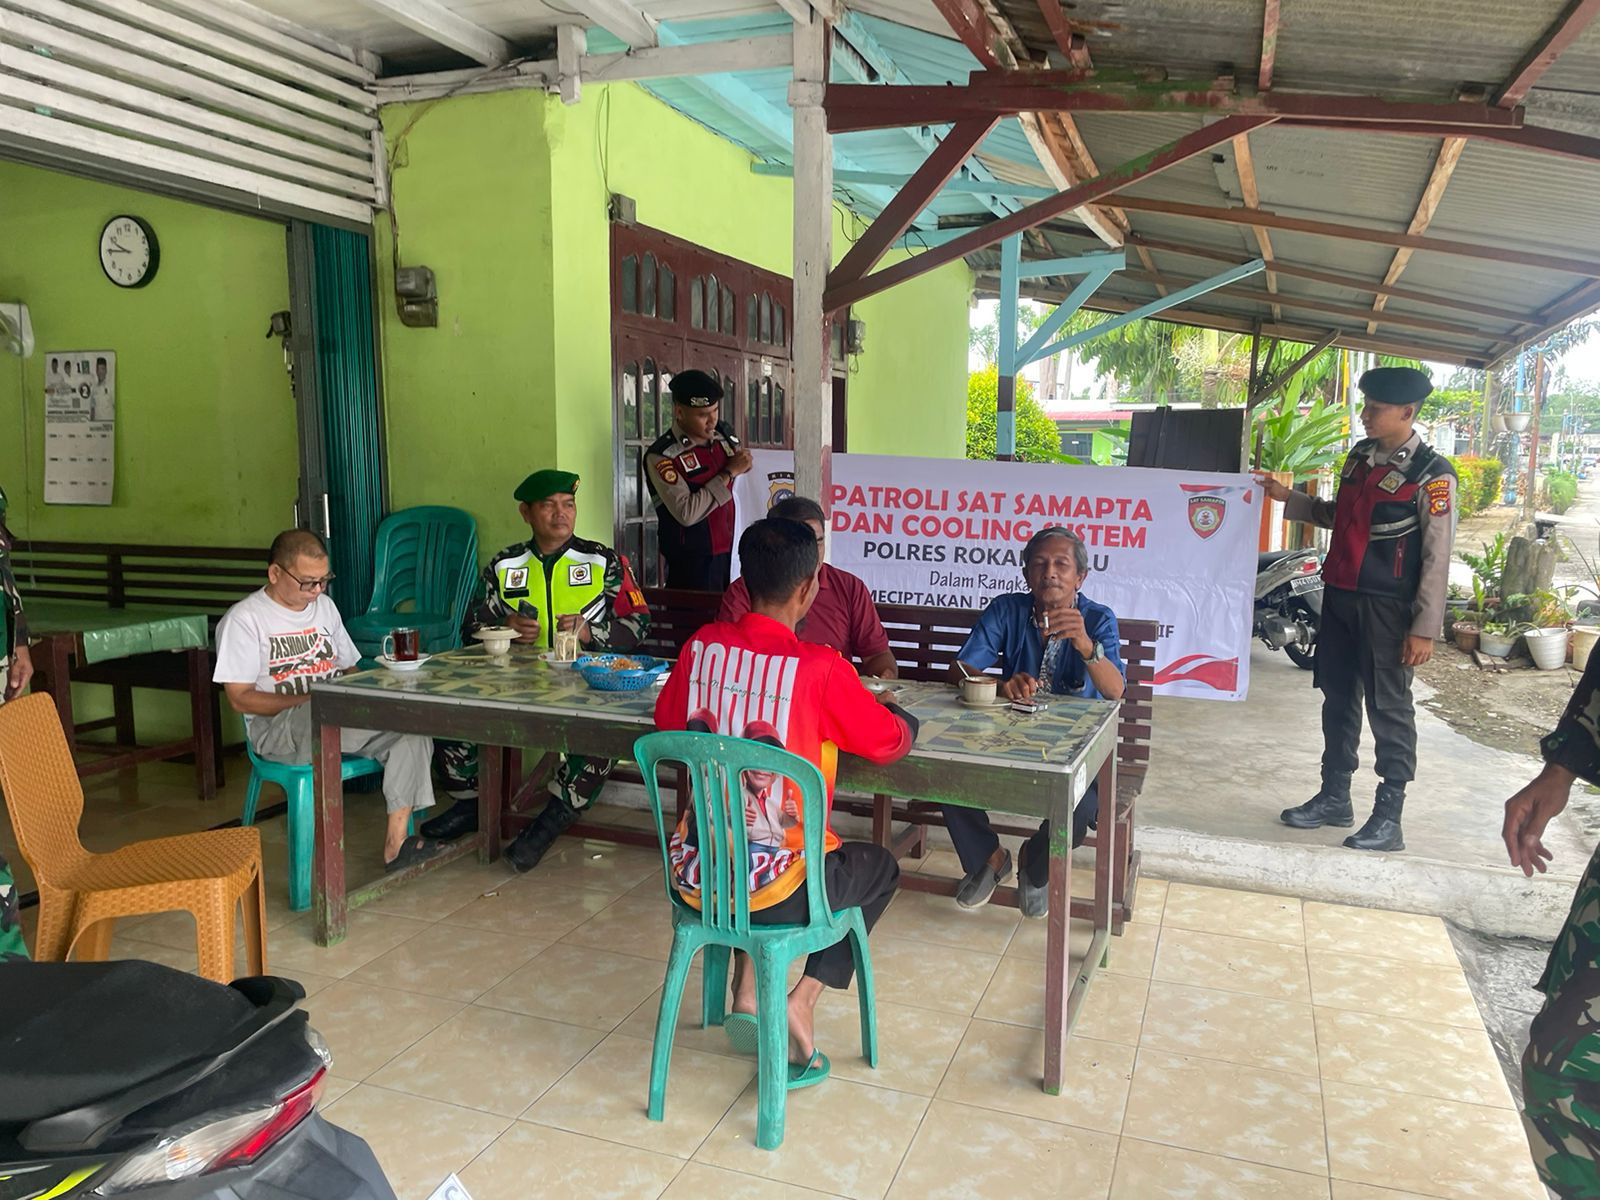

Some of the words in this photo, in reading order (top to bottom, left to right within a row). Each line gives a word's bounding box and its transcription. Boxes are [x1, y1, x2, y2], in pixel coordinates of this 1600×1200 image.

[831, 484, 949, 511] PATROLI
[957, 490, 1006, 514] SAT
[1013, 493, 1153, 521] SAMAPTA
[831, 511, 894, 534] DAN
[902, 514, 1033, 542] COOLING
[863, 541, 946, 562] POLRES
[929, 570, 974, 588] Dalam
[978, 573, 1031, 594] Rangka
[268, 634, 310, 661] FASHION
